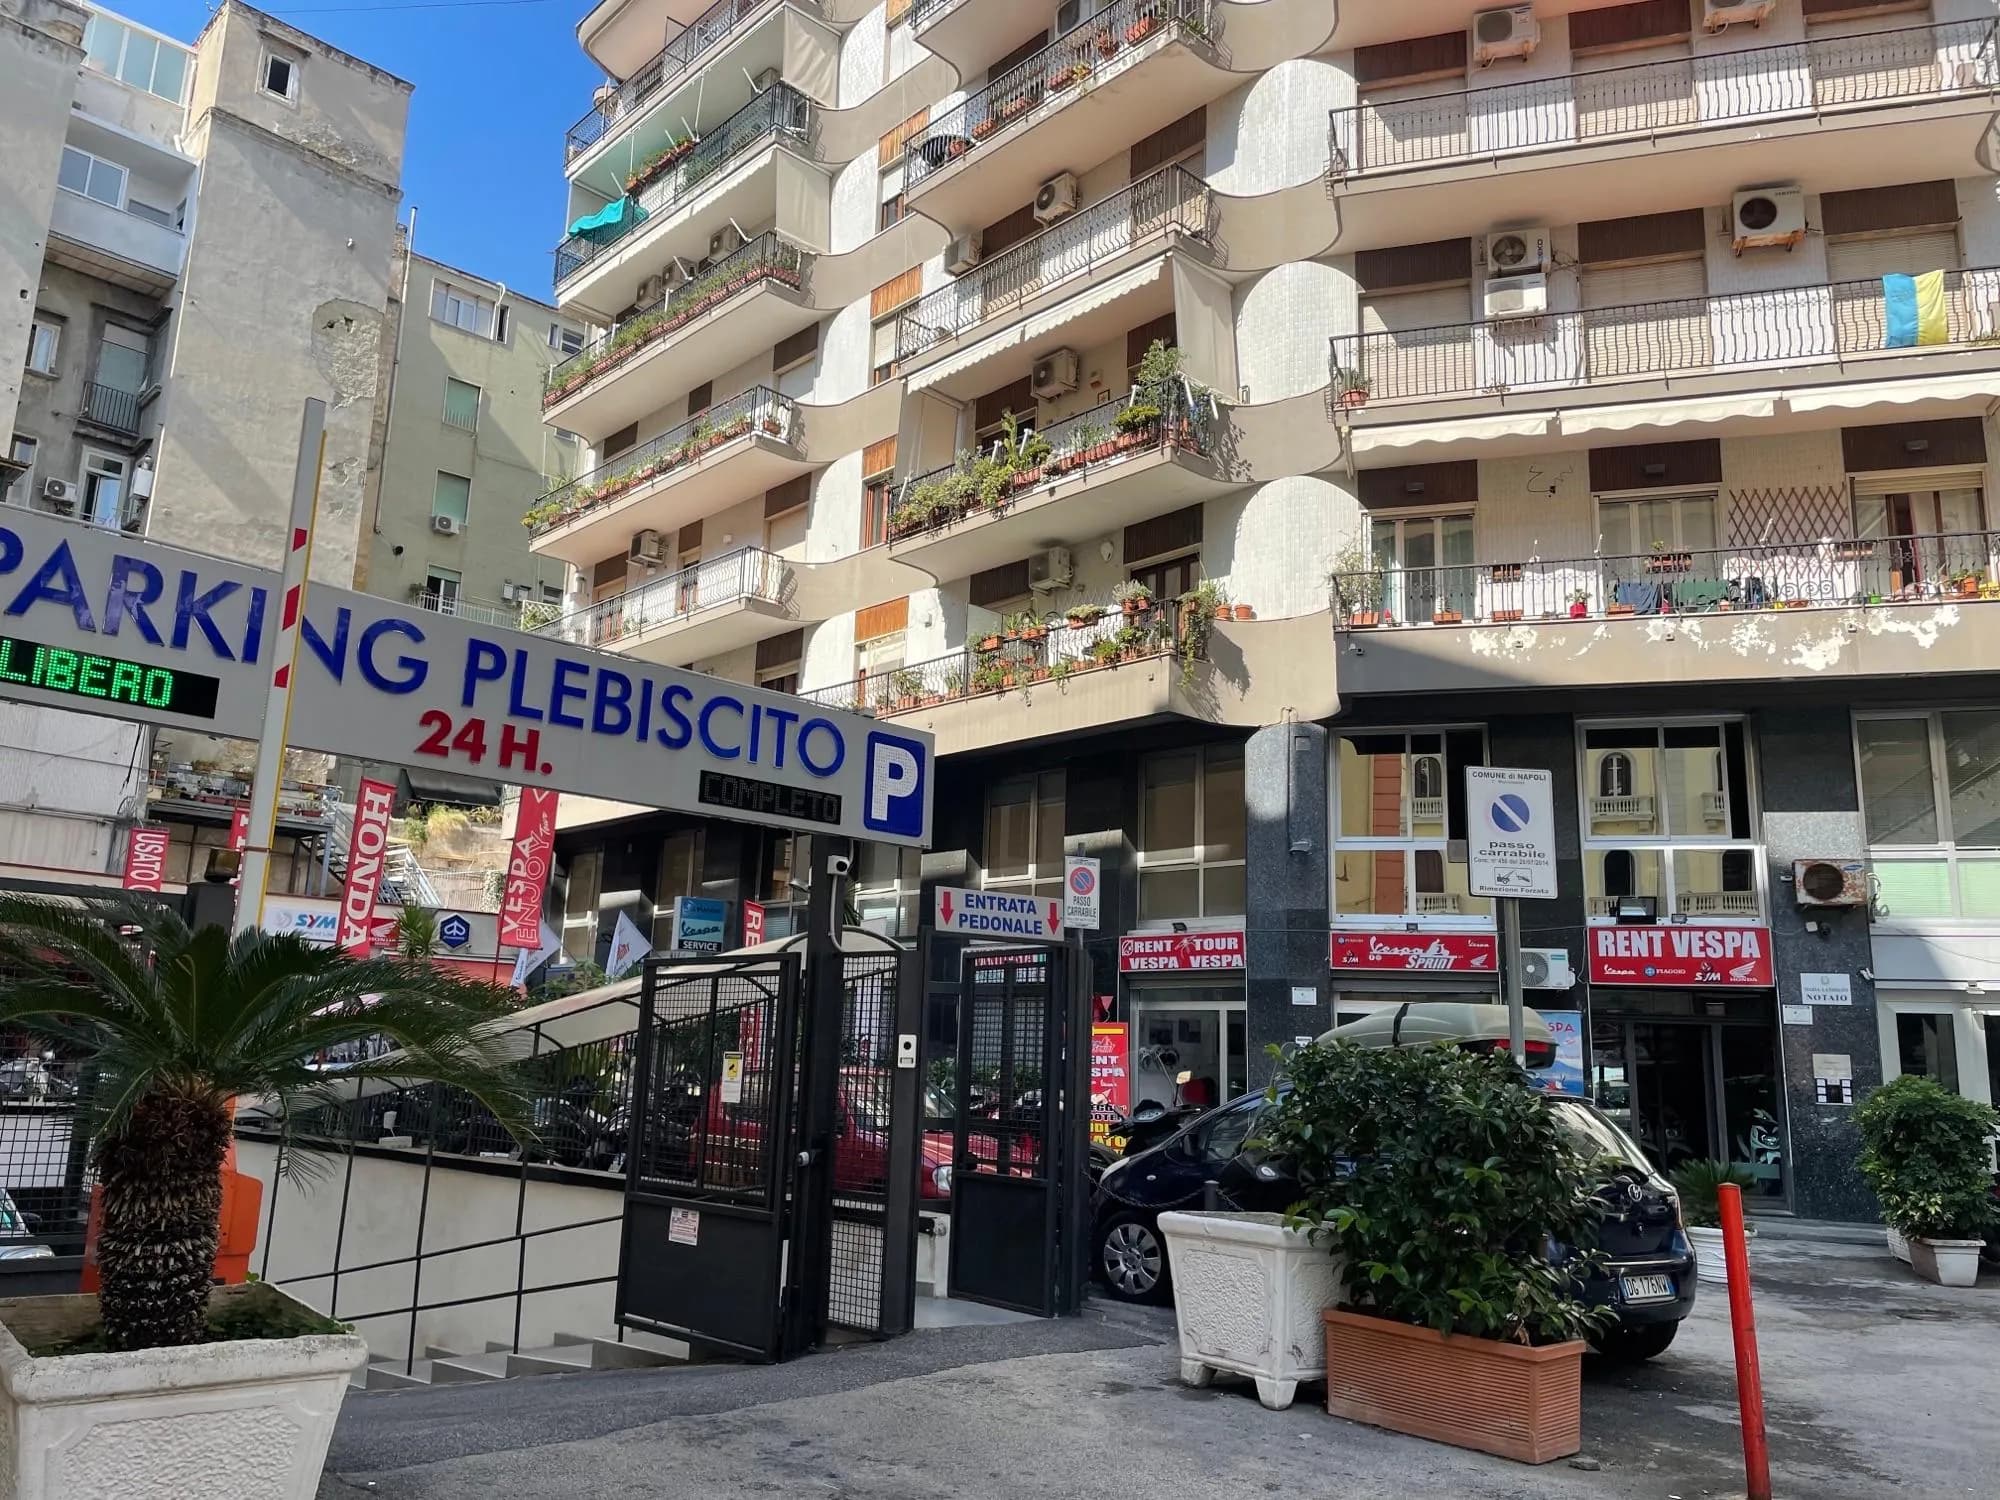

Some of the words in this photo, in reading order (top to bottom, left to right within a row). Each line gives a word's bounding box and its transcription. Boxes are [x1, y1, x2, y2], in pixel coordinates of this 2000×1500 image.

[0, 639, 174, 708] LIBERO
[460, 637, 846, 779] PLEBISCITO
[413, 709, 486, 766] 24
[499, 723, 554, 776] H.
[870, 742, 919, 822] P
[1472, 771, 1506, 779] COMUNE
[702, 774, 838, 821] COMPLETO
[129, 832, 166, 881] USATO
[1479, 850, 1546, 859] carrabile
[1489, 841, 1535, 849] passo
[341, 787, 391, 947] HONDA
[502, 836, 535, 935] VESPA
[516, 830, 550, 944] ENJOY
[964, 893, 1038, 915] ENTRATA
[296, 913, 336, 929] SYM
[681, 920, 721, 937] Vespa
[958, 913, 1043, 936] PEDONALE
[682, 940, 718, 951] SERVICE
[1133, 939, 1174, 954] RENT
[1192, 937, 1239, 952] TOUR
[1369, 935, 1424, 956] Vespa
[1597, 930, 1665, 957] RENT
[1670, 930, 1761, 958] VESPA
[1128, 956, 1179, 969] VESPA
[1189, 954, 1243, 968] VESPA
